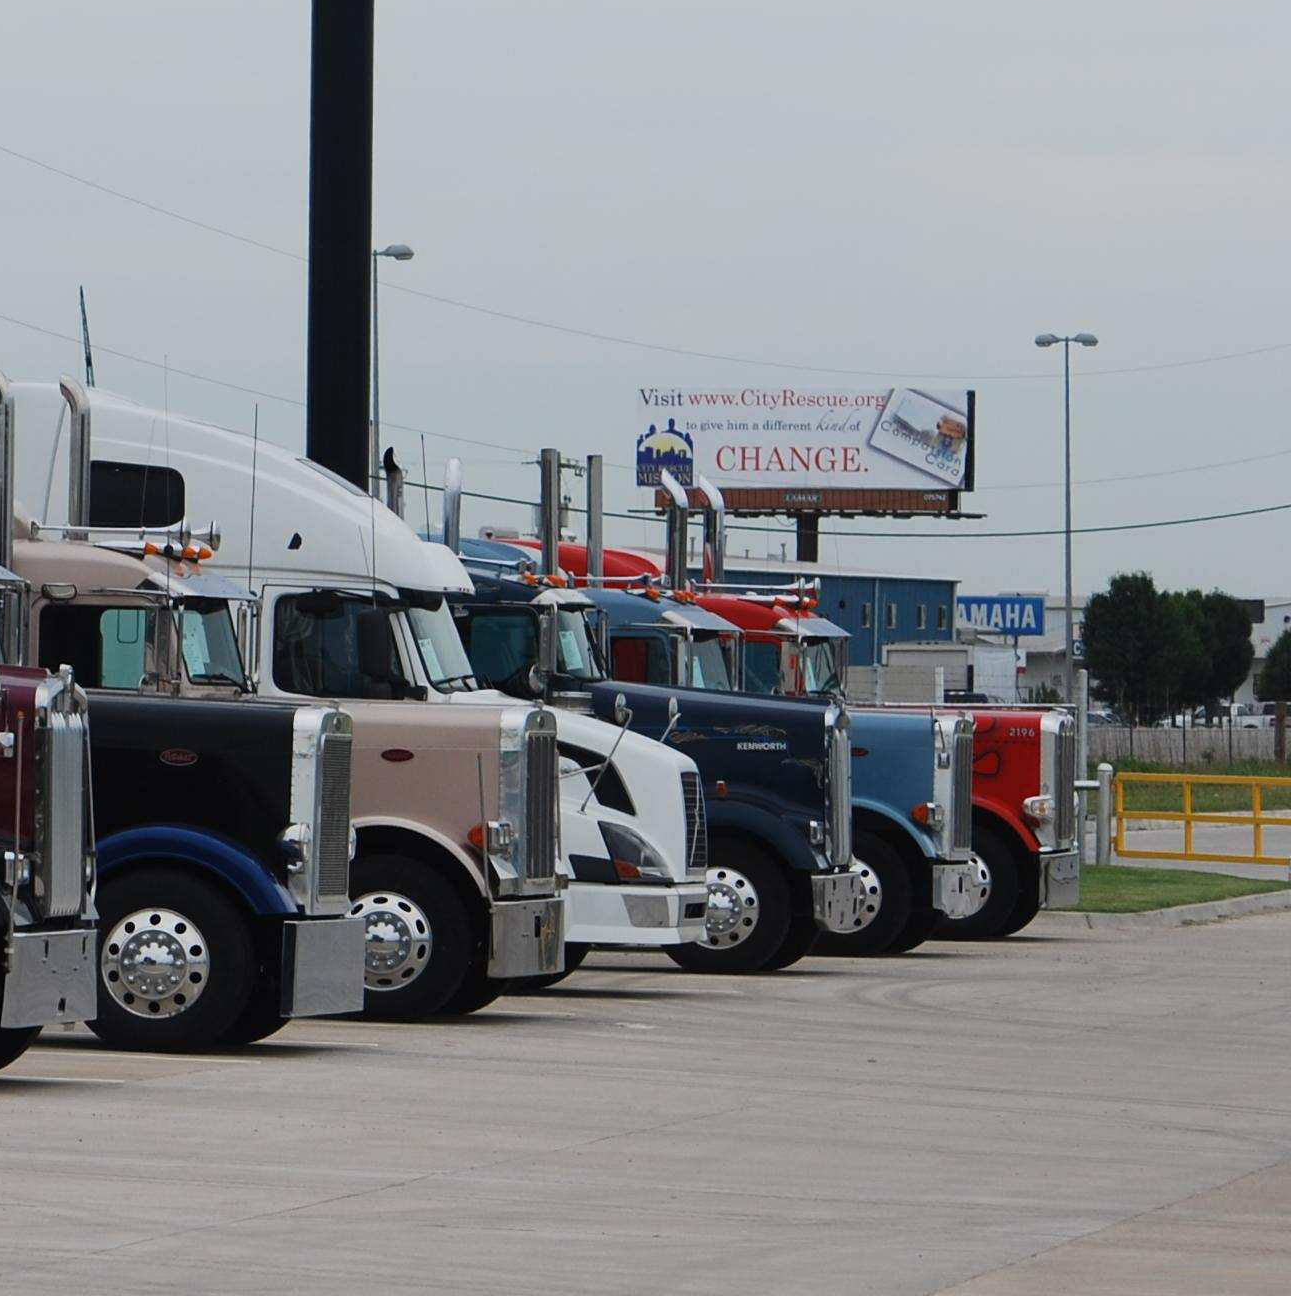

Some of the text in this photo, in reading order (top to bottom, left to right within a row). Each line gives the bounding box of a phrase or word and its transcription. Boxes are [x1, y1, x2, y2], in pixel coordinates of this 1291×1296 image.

[640, 388, 887, 413] Visit www.CityRescue.org
[686, 421, 697, 431] to
[700, 419, 724, 432] give
[727, 419, 749, 431] him
[752, 423, 760, 431] a
[762, 419, 812, 432] different
[849, 421, 861, 431] of
[716, 445, 869, 473] CHANGE.
[637, 472, 692, 485] MISON
[957, 602, 1037, 629] AMAHA
[736, 742, 787, 751] KENWORTH
